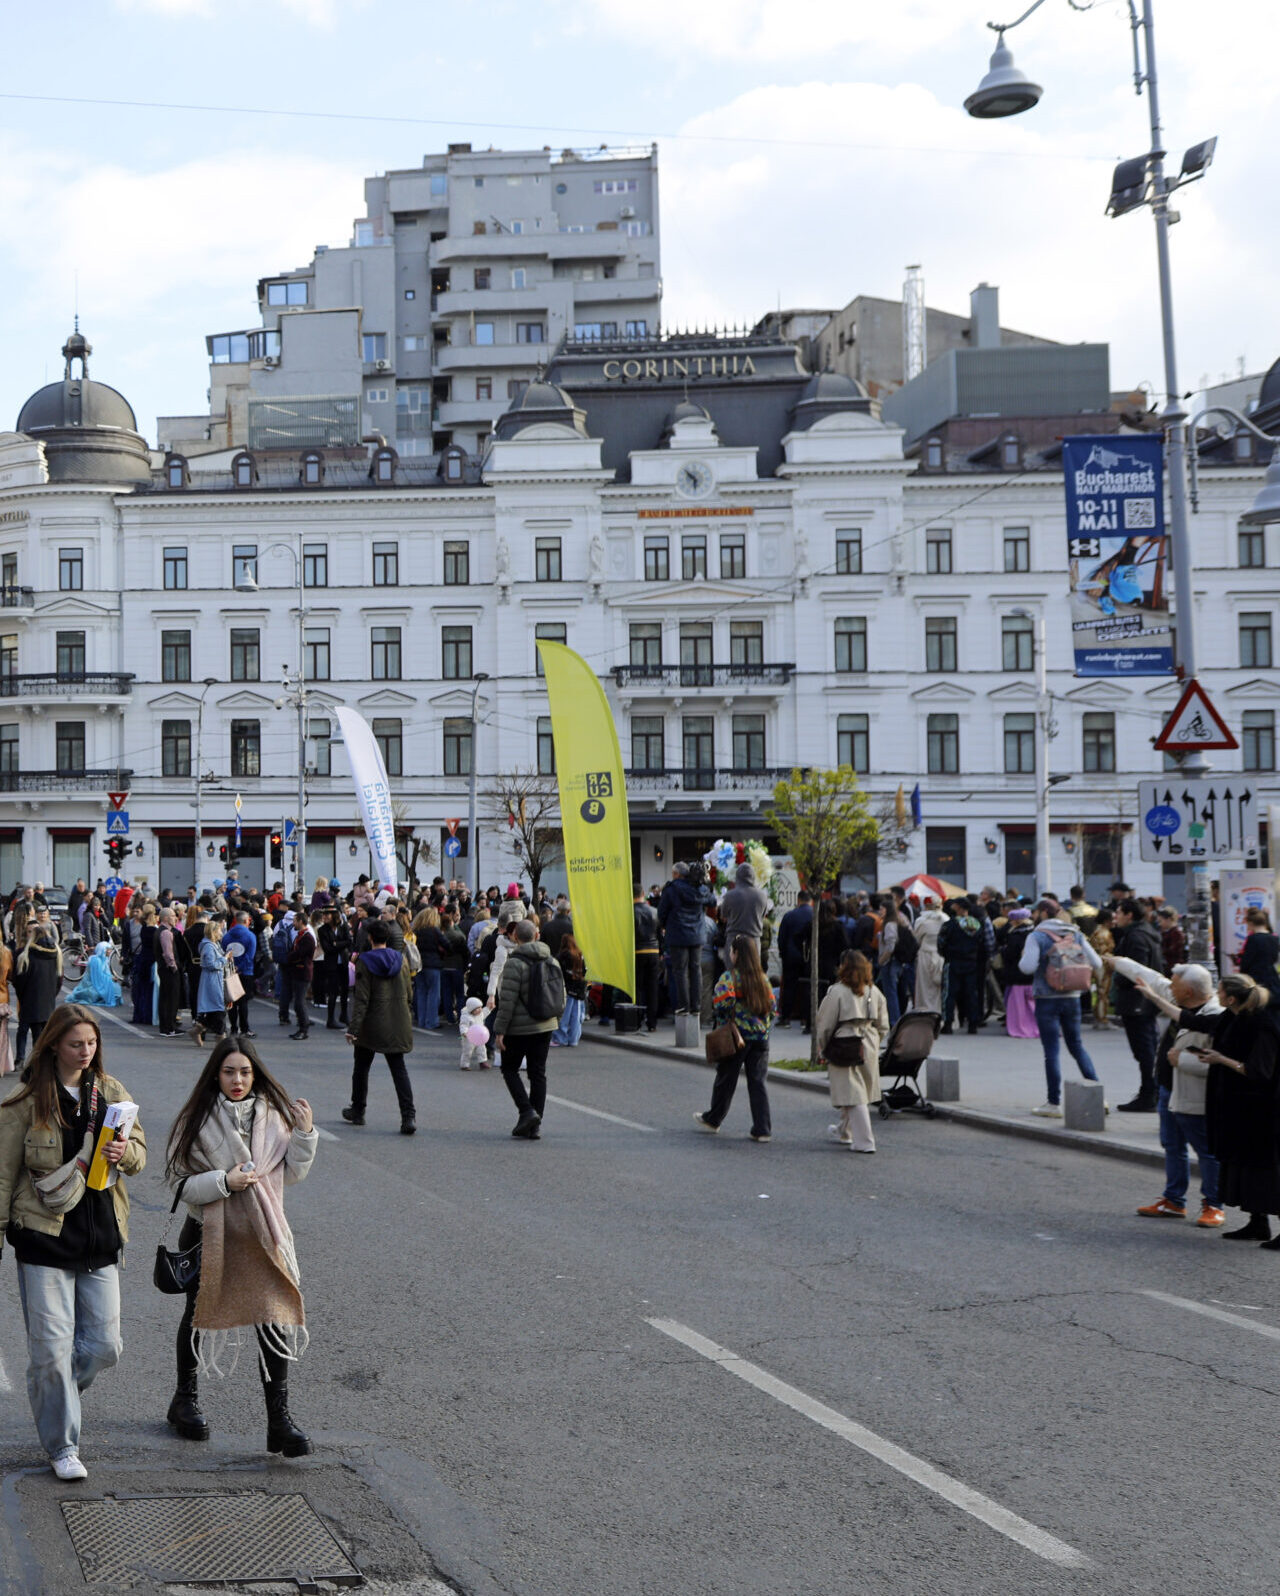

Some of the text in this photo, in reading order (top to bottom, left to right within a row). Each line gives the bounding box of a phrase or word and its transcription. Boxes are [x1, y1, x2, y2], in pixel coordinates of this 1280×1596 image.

[603, 355, 756, 379] CORINTHIA
[1075, 470, 1155, 486] Bucharest
[1076, 483, 1155, 495] HALF MARATHON
[1076, 499, 1117, 514] 10-11
[1078, 514, 1118, 530] MAI
